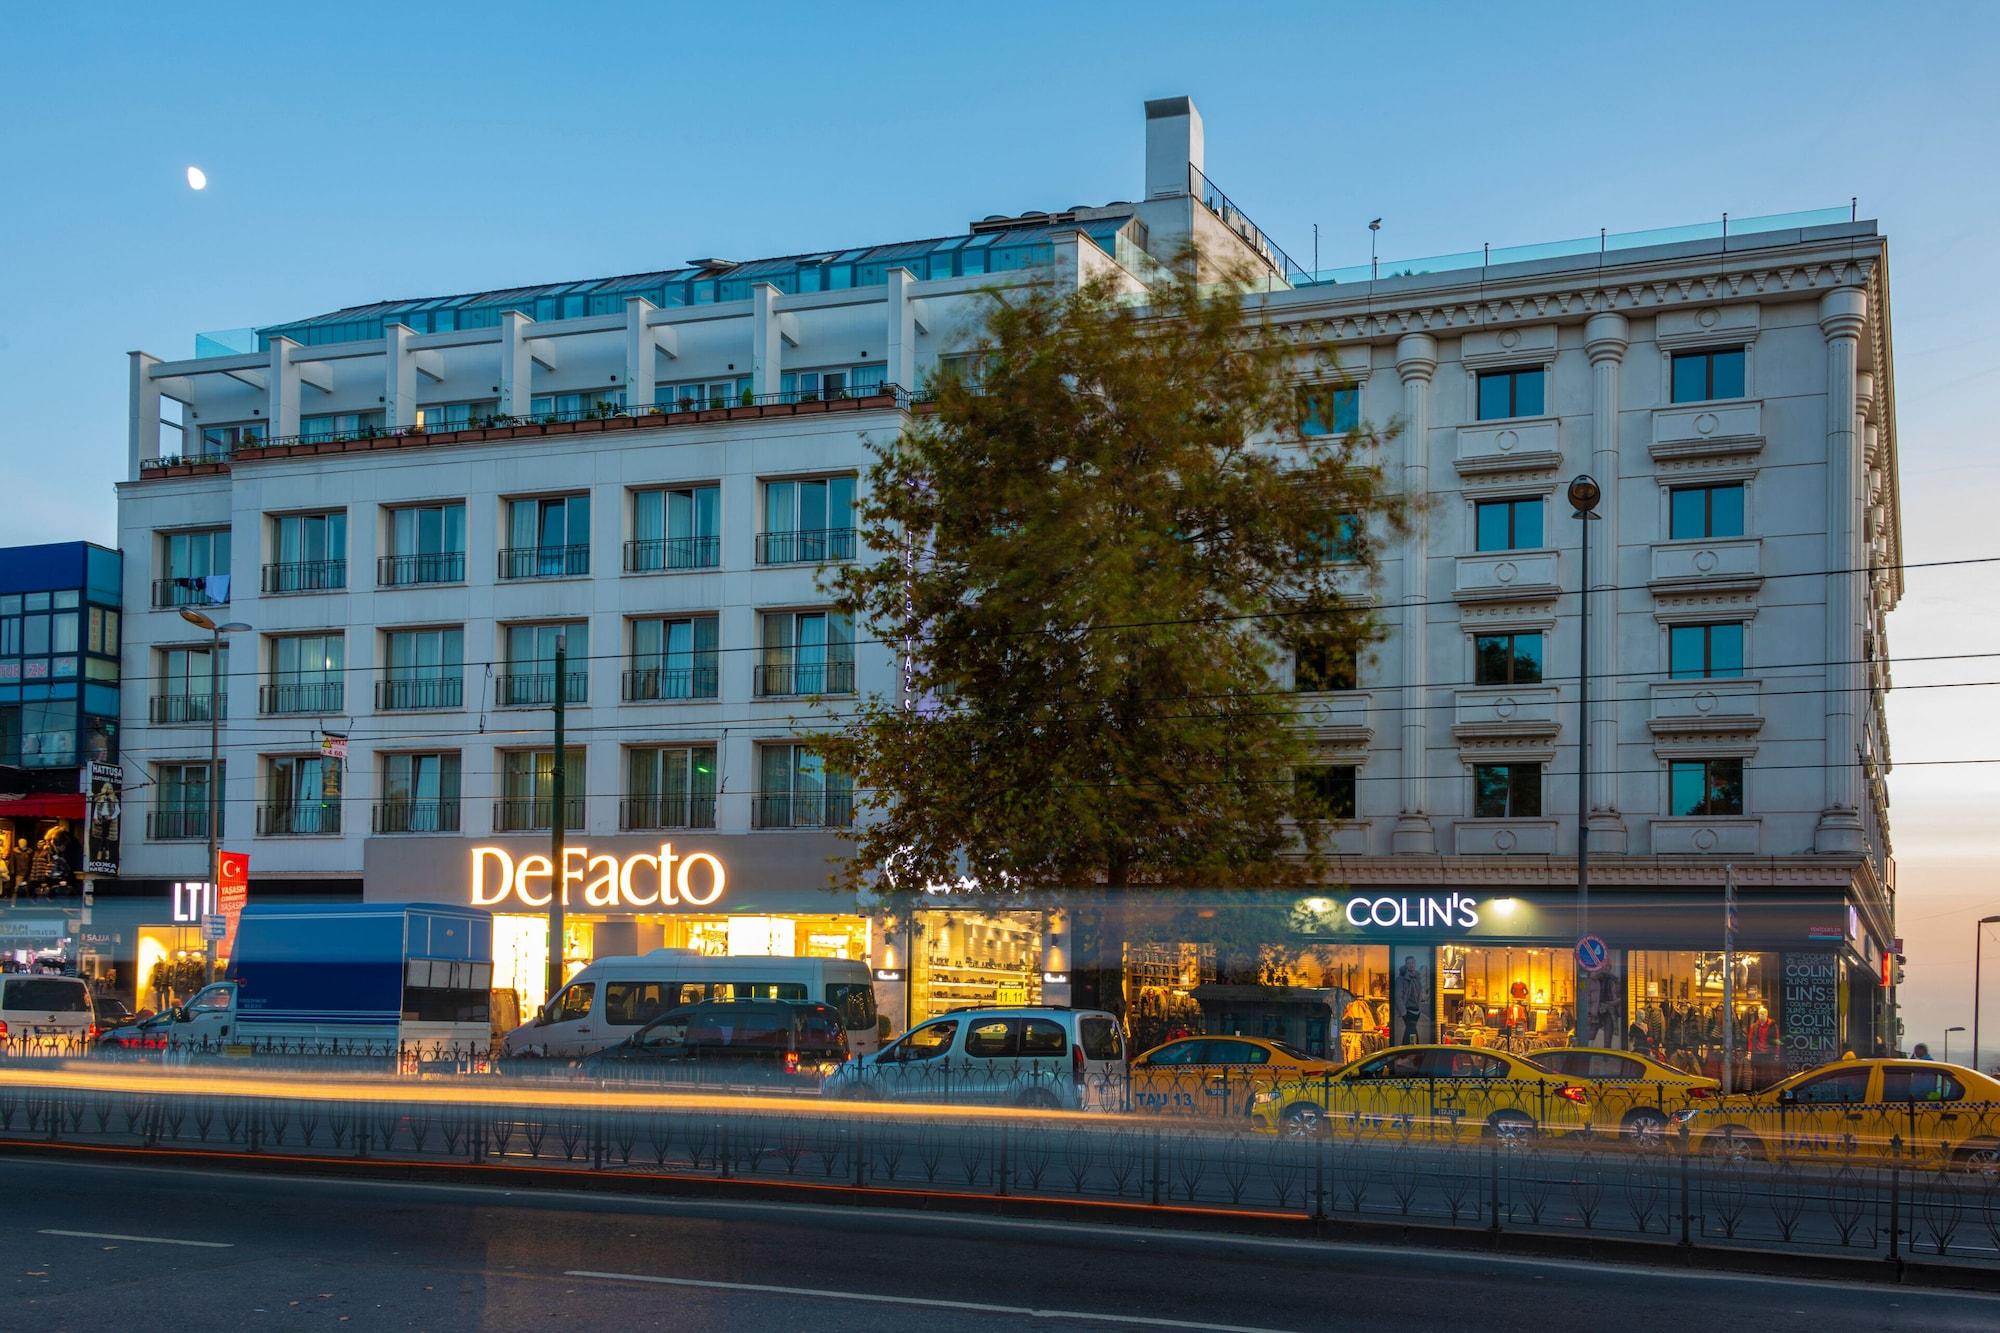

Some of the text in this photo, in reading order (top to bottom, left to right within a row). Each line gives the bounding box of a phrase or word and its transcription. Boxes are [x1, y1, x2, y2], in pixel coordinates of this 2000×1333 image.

[470, 842, 727, 907] DeFacto
[1345, 892, 1479, 928] COLIN'S
[1786, 964, 1834, 977] COLIN
[1786, 985, 1826, 1002] LIN'S
[1136, 1092, 1168, 1106] TAU
